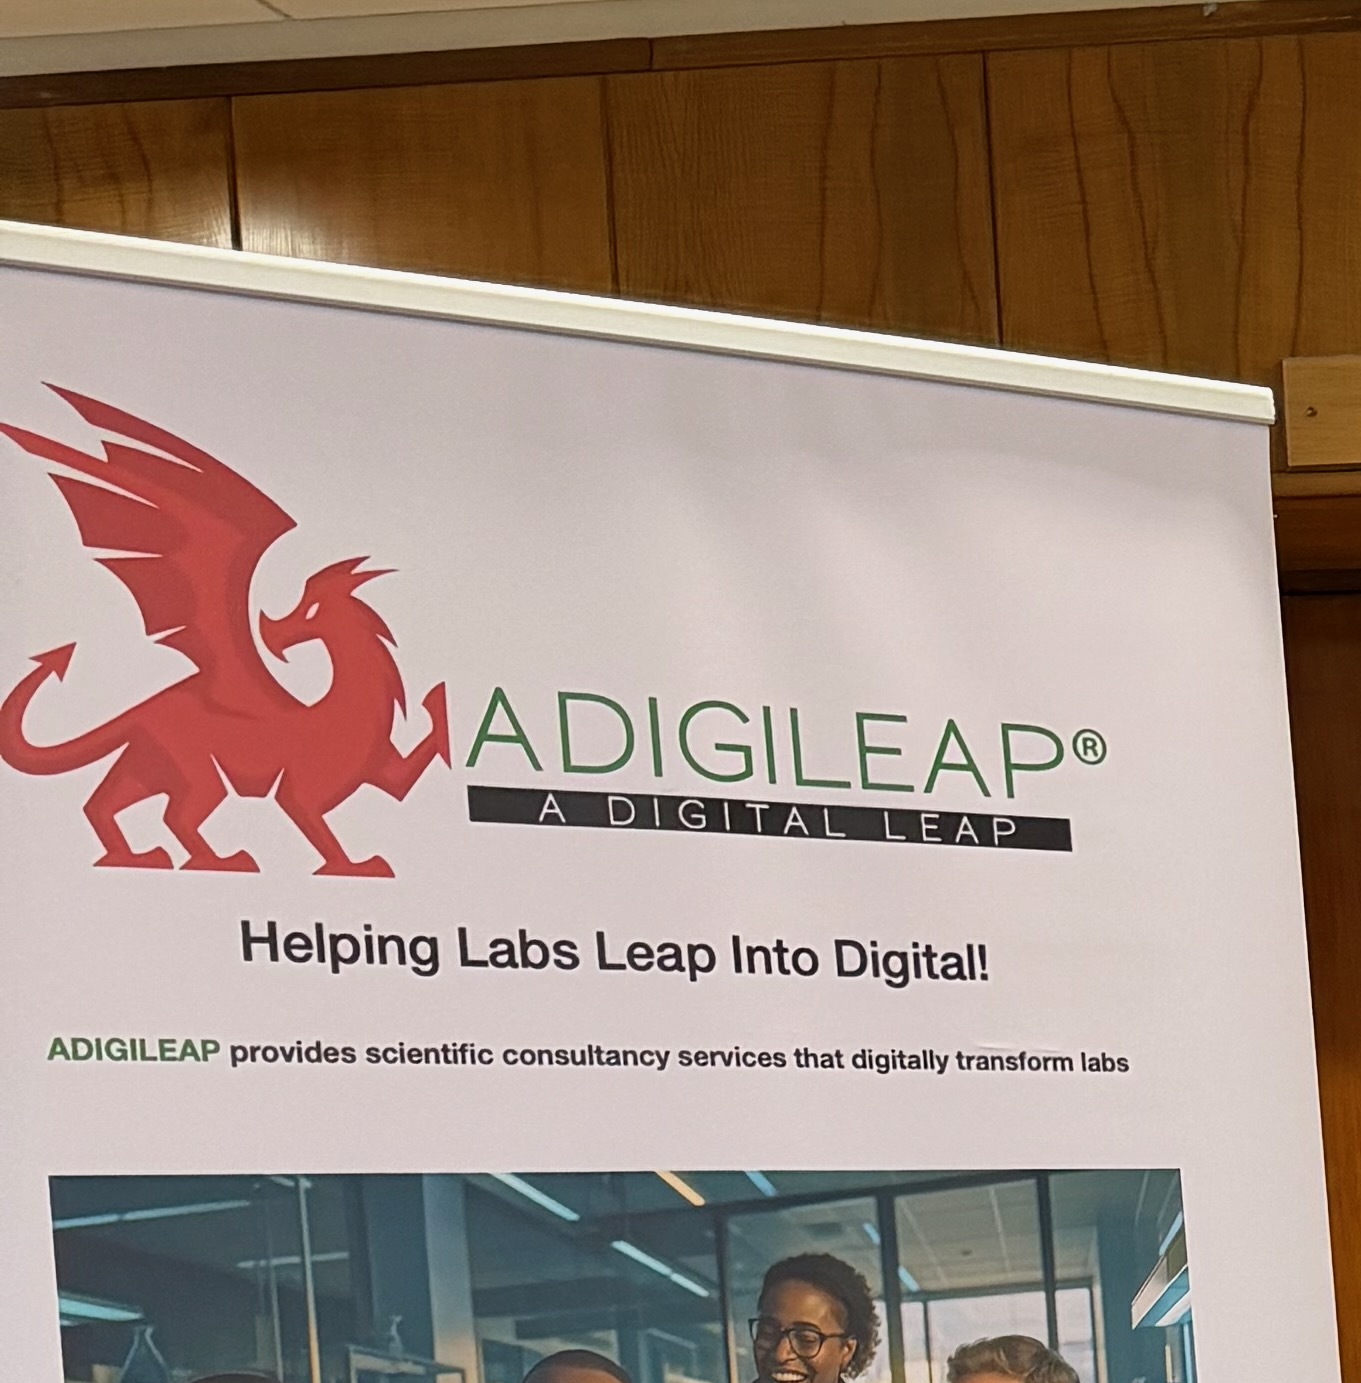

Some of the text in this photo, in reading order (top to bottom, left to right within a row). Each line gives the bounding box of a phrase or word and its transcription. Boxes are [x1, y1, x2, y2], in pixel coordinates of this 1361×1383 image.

[536, 793, 1019, 847] A DIGITAL LEAP
[240, 919, 989, 989] Helping Labs Leap Into Digital!
[47, 1036, 1130, 1075] ADIGILEAP provides scientific consultancy services that digitally transform labs
